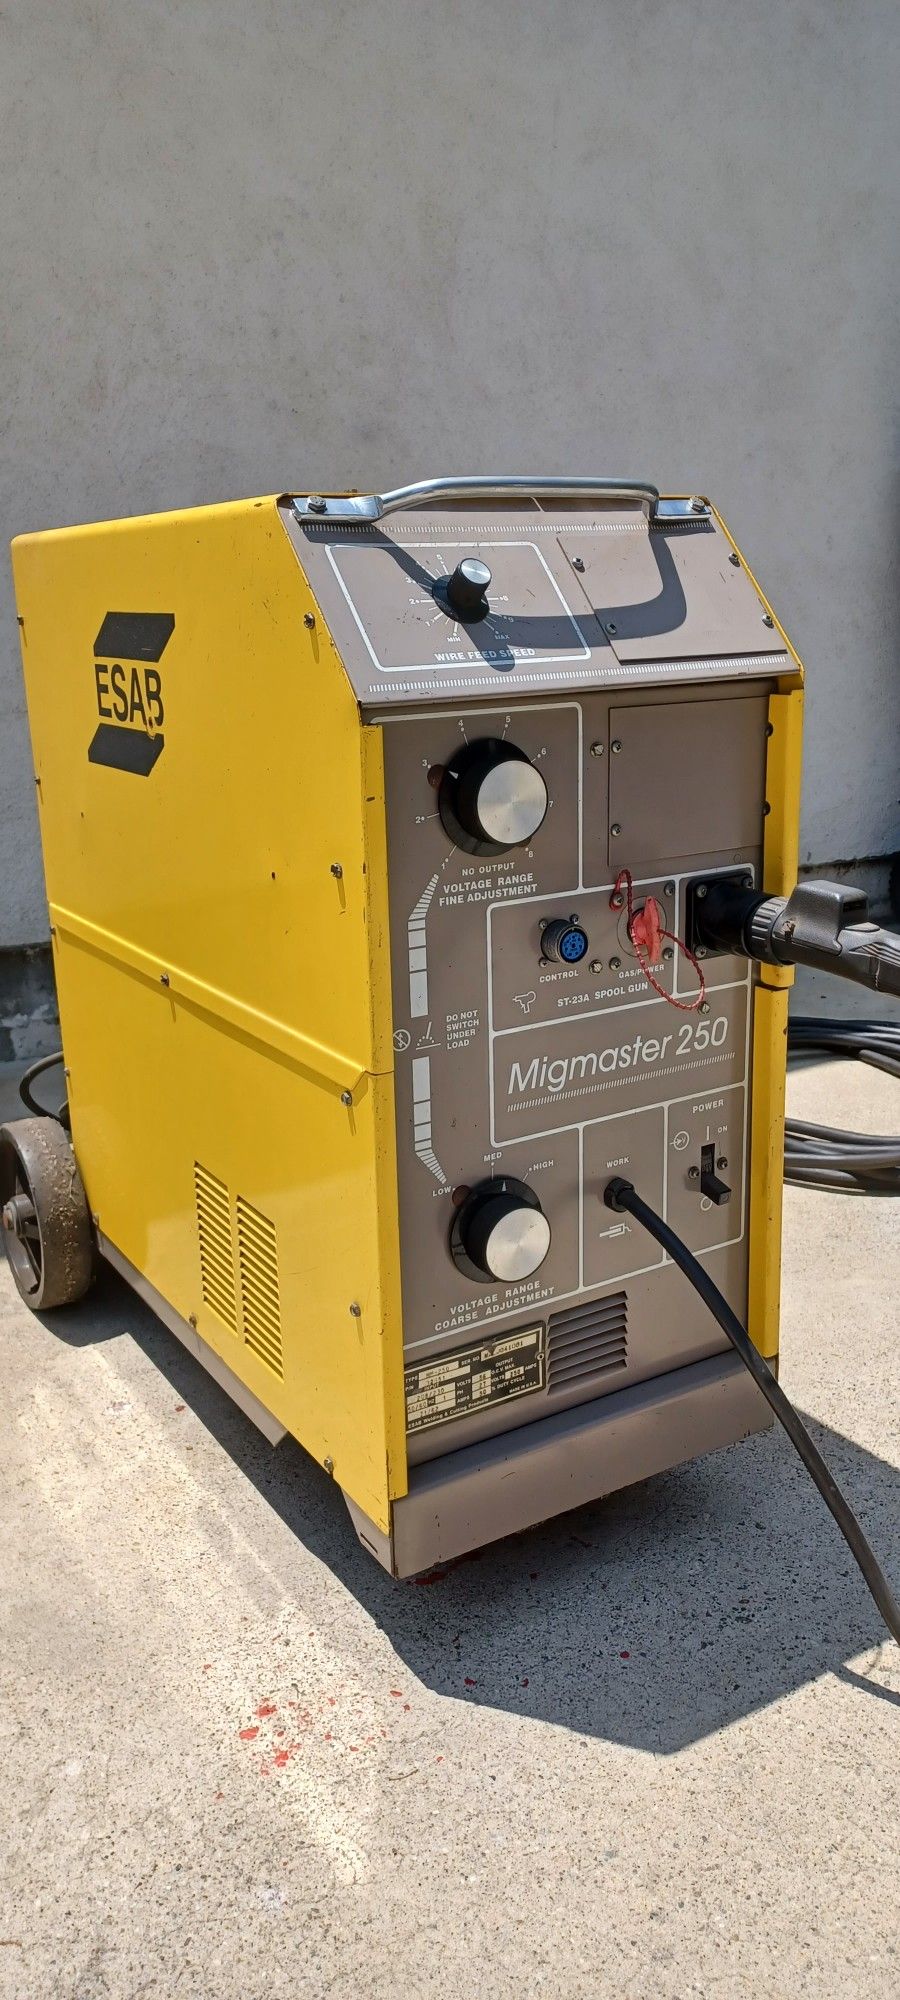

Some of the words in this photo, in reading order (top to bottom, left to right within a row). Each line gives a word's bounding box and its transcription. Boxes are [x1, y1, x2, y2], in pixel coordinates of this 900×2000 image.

[434, 651, 466, 661] WIRE
[468, 650, 497, 659] FEED
[499, 648, 535, 658] SPEED
[94, 664, 164, 728] ESAB
[422, 759, 428, 767] 3
[415, 816, 421, 824] 2
[528, 850, 534, 858] 8
[462, 867, 475, 876] NO
[479, 862, 515, 874] OUTPUT
[443, 878, 492, 894] VOLTAGE
[498, 872, 534, 886] RANGE
[439, 896, 464, 907] FINE
[466, 883, 538, 902] ADJUSTMENT
[539, 970, 579, 983] CONTROL
[557, 994, 590, 1007] ST-23A
[594, 986, 626, 1000] SPOOL
[628, 982, 649, 993] GUN
[446, 1014, 459, 1022] DO
[461, 1009, 478, 1019] NOT
[446, 1019, 480, 1032] SWITCH
[446, 1029, 476, 1040] UNDER
[447, 1039, 470, 1050] LOAD
[508, 1035, 673, 1095] Migmaster
[675, 1016, 729, 1056] 250
[692, 1099, 724, 1113] POWER
[483, 1151, 503, 1162] MED
[606, 1156, 629, 1168] WORK
[533, 1160, 555, 1171] HIGH
[432, 1186, 452, 1197] LOW
[450, 1293, 499, 1315] VOLTAGE
[505, 1280, 541, 1298] RANGE
[434, 1312, 479, 1332] COARSE
[485, 1286, 556, 1316] ADJUSTMENT
[495, 1357, 513, 1368] OUTPUT
[405, 1375, 418, 1383] TYPE
[491, 1374, 505, 1383] VOLTS
[524, 1362, 537, 1371] AMPS
[456, 1378, 471, 1387] VOLTS
[496, 1381, 509, 1389] DUTY
[510, 1375, 525, 1384] CYCLE
[457, 1395, 470, 1403] AMPS
[408, 1420, 422, 1429] ESAB
[423, 1413, 444, 1423] Welding
[449, 1405, 468, 1415] Cutting
